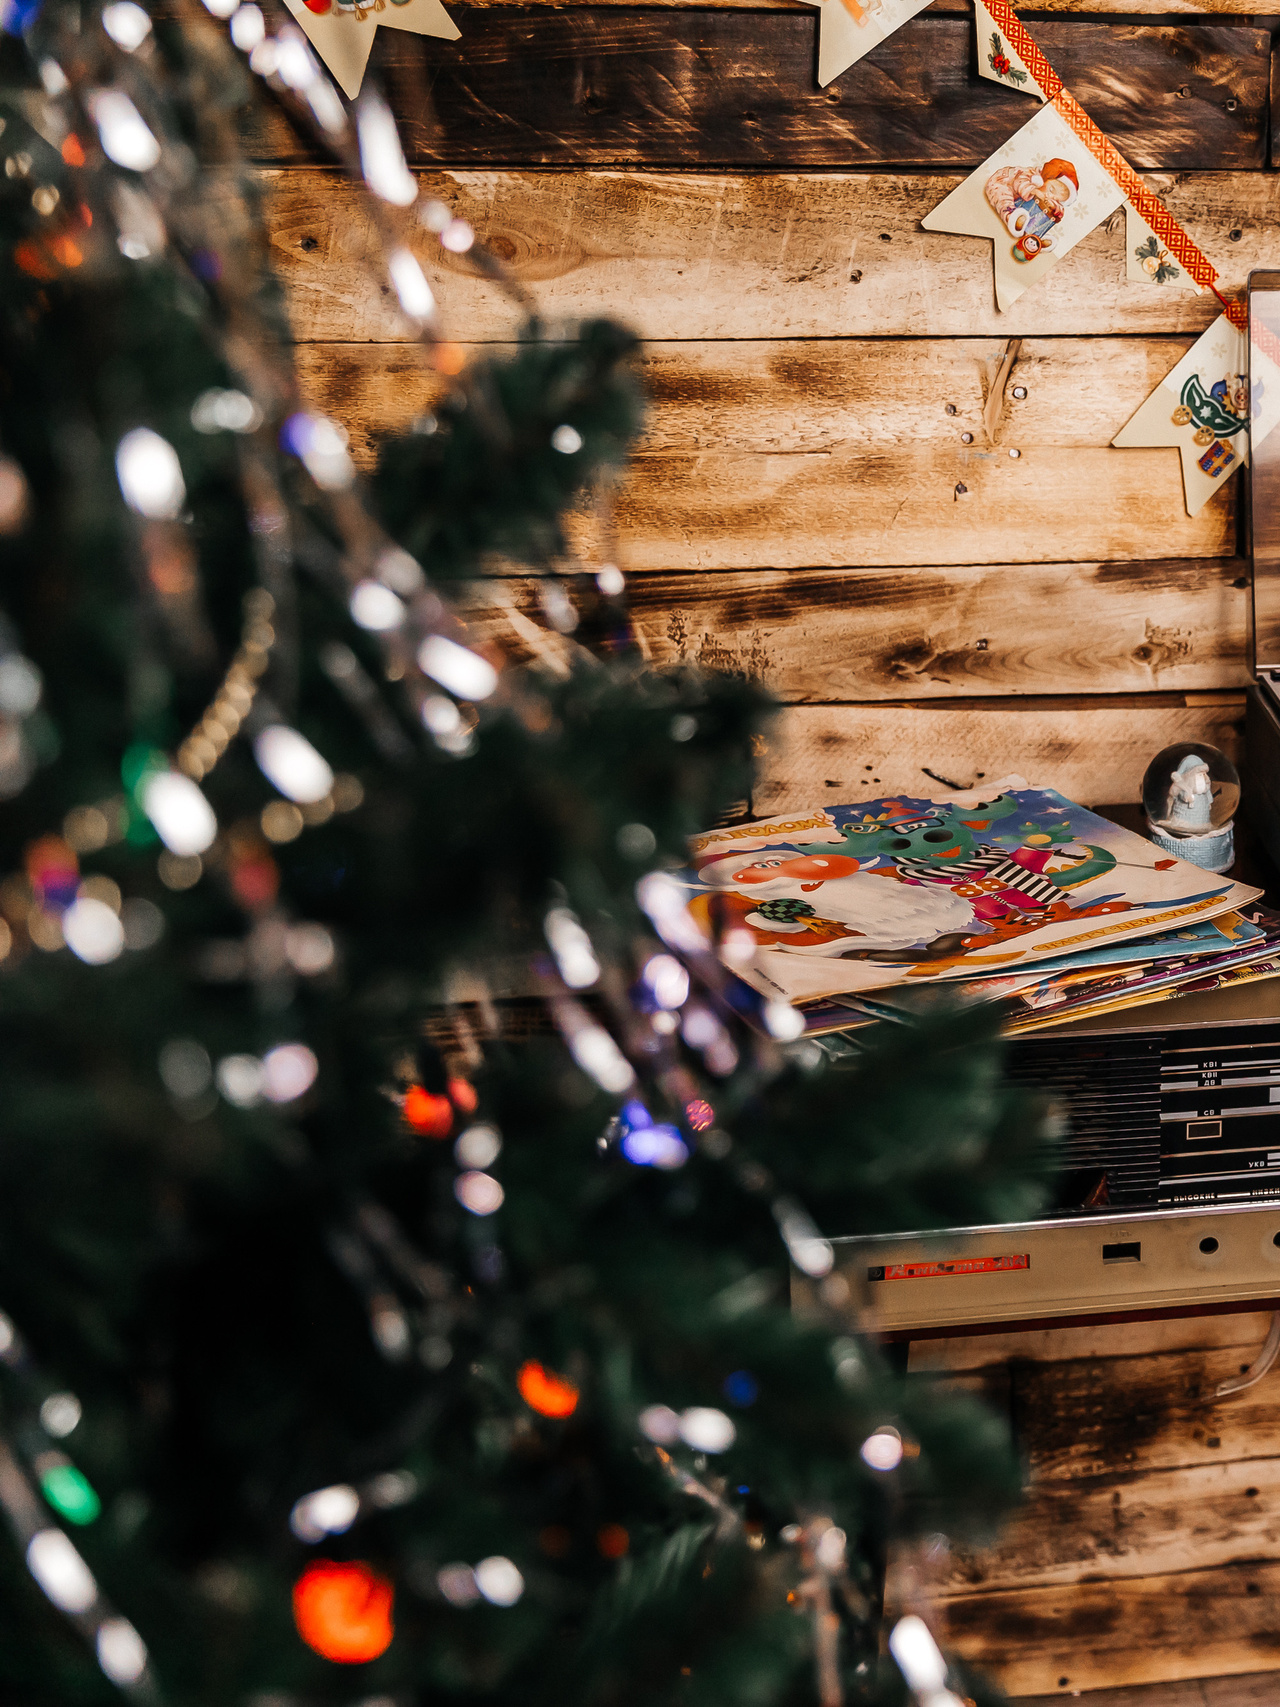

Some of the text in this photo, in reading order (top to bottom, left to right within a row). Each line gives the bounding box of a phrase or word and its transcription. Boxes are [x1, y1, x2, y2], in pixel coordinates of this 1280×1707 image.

[1119, 917, 1158, 933] NEW
[1248, 1160, 1265, 1168] УКВ
[1173, 1192, 1215, 1202] ВЫСОКИЕ
